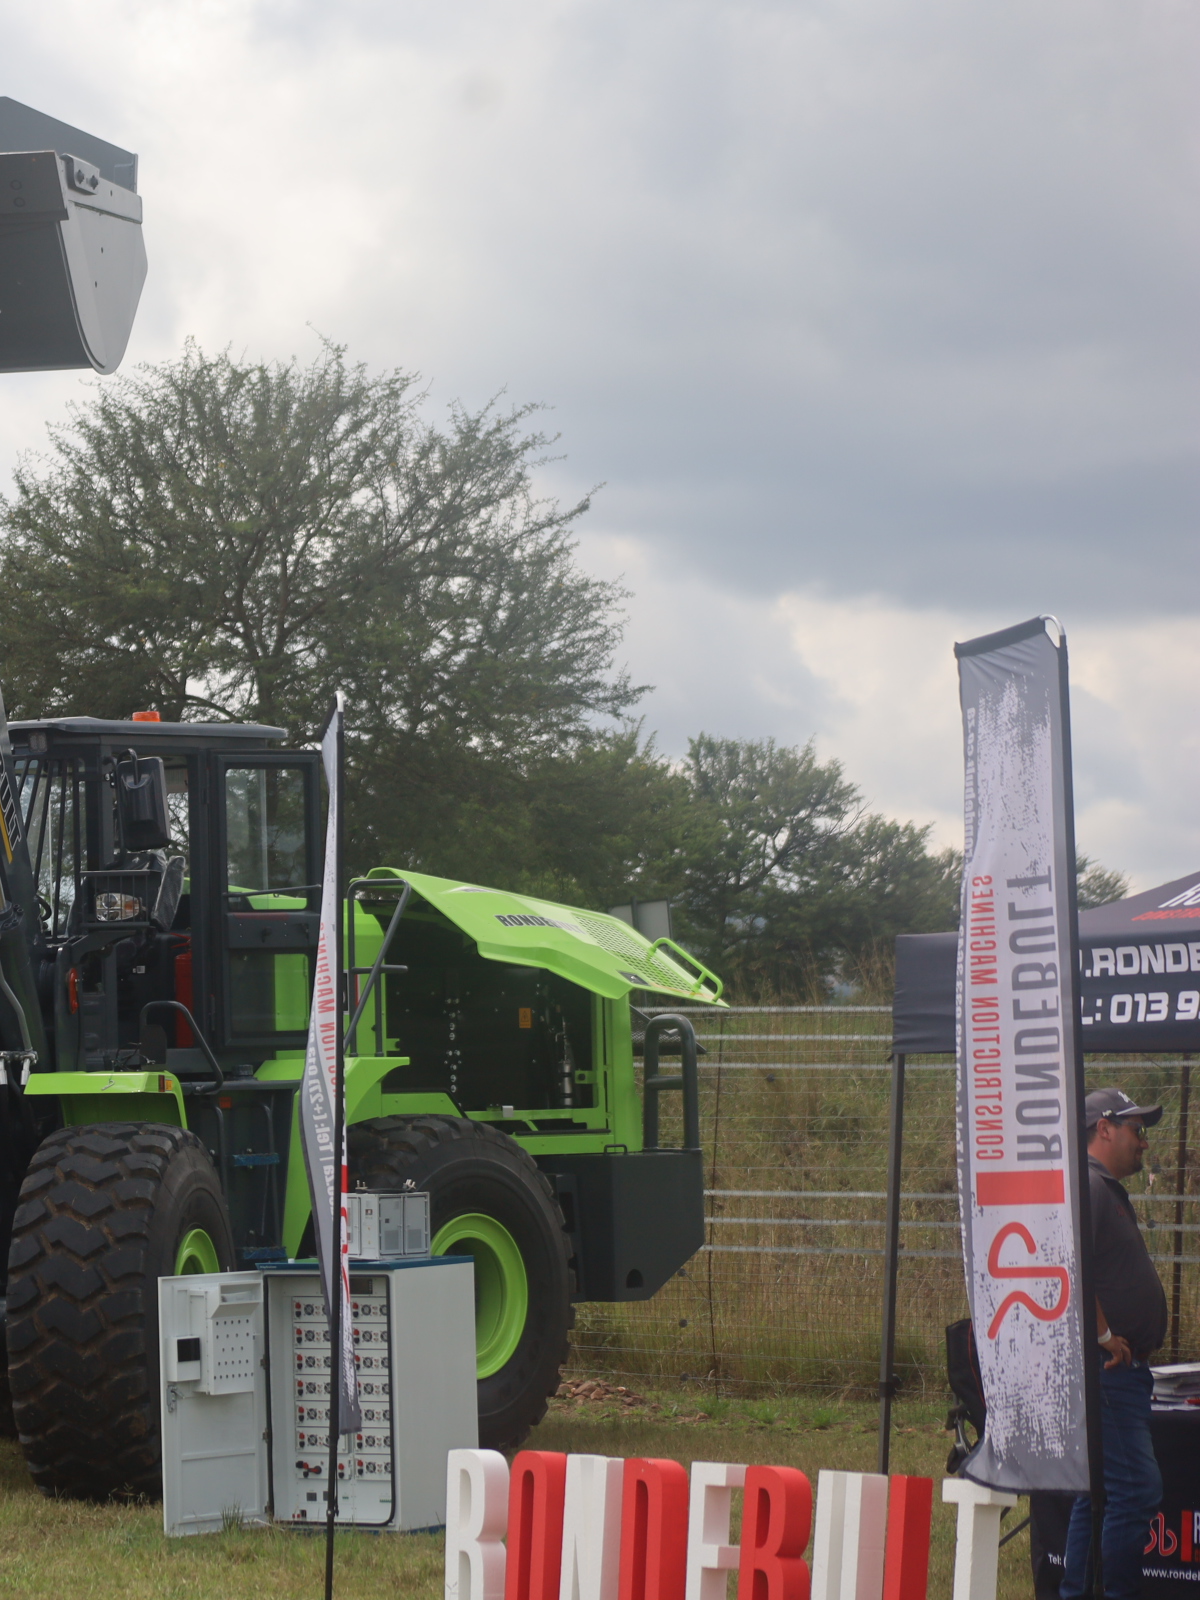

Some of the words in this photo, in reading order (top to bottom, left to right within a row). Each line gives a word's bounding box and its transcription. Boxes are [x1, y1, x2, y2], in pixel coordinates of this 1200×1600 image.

[1109, 991, 1169, 1024] 013
[1175, 990, 1200, 1021] 9
[445, 1448, 1018, 1600] RONDEBULT
[1047, 1553, 1062, 1566] Tel:
